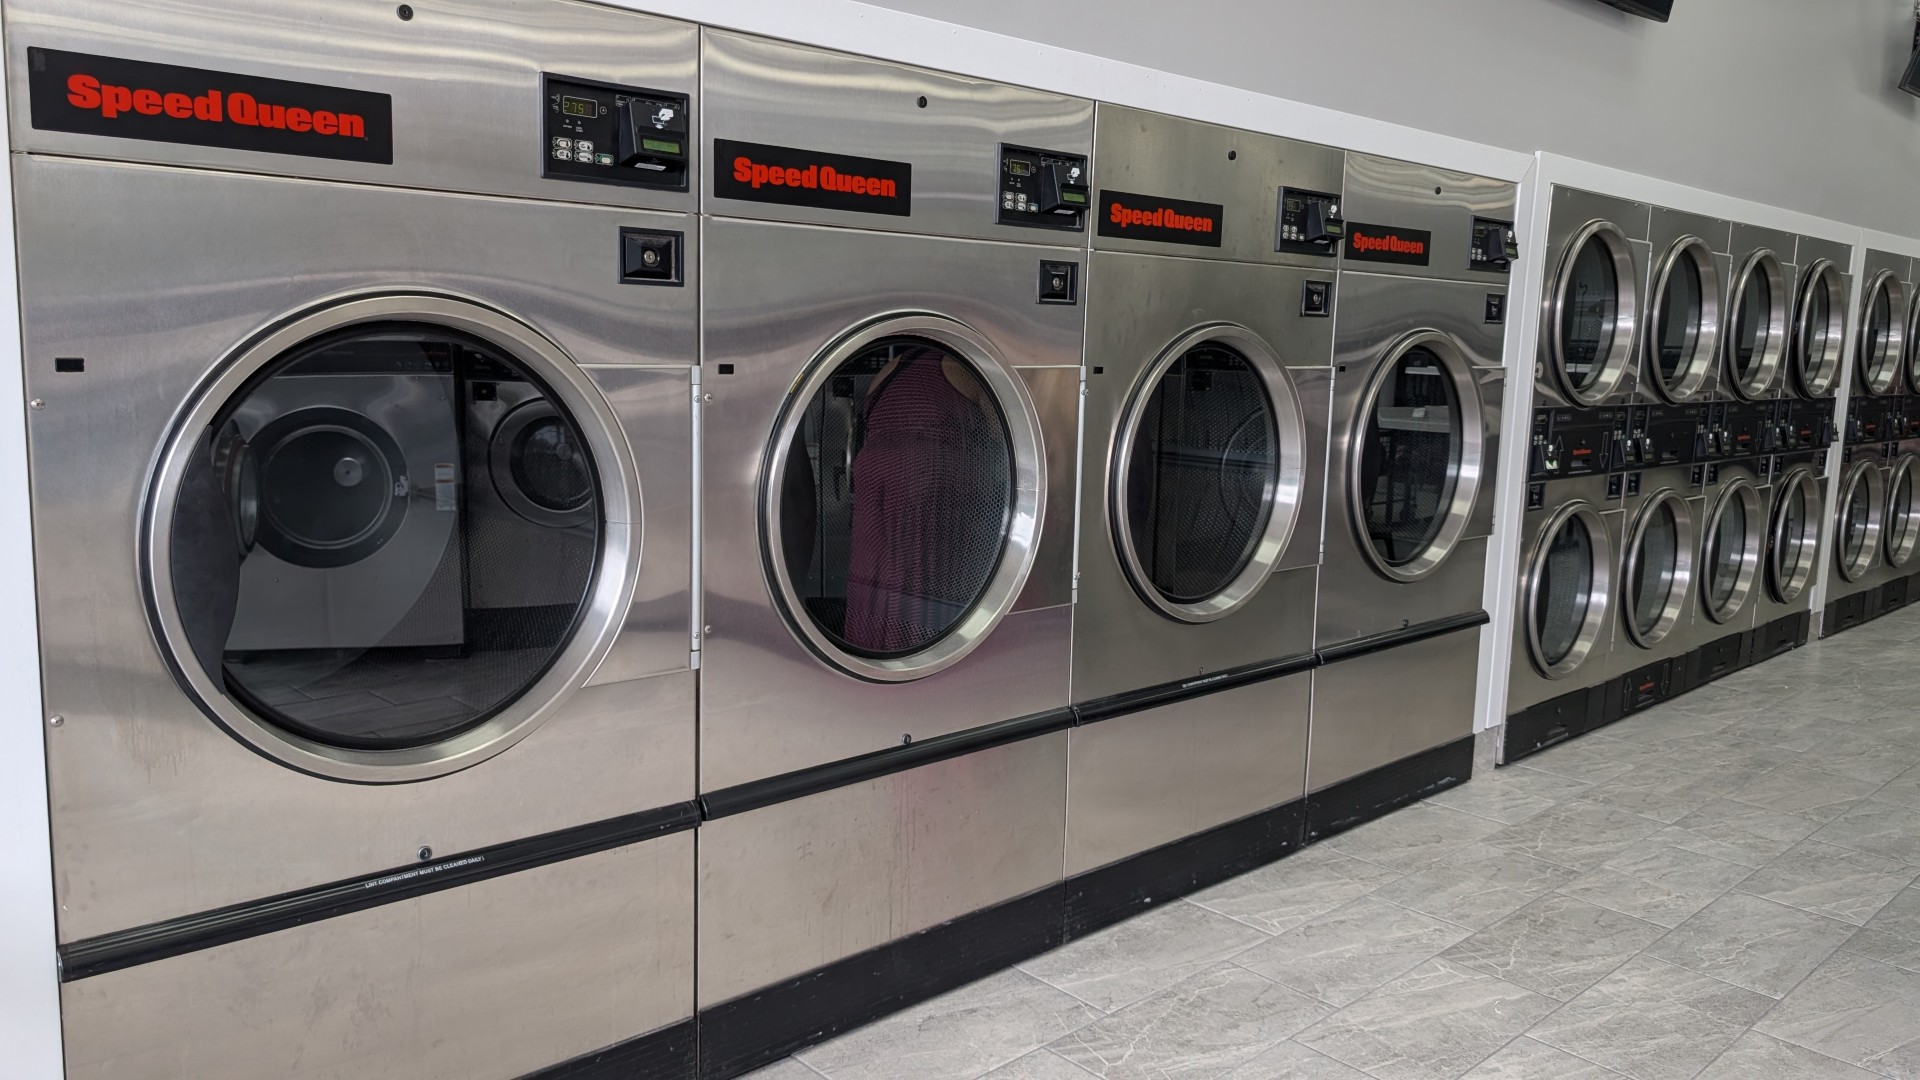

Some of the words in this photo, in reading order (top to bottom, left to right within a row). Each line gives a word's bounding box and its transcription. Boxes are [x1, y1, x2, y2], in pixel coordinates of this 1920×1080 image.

[67, 74, 223, 122] Speed
[227, 92, 365, 138] Queen
[733, 157, 818, 188] Speed
[819, 166, 896, 197] Queen
[1110, 203, 1163, 228] Speed
[1163, 209, 1213, 232] Queen
[1353, 232, 1390, 252] Speed
[1390, 235, 1424, 254] Queen
[378, 871, 419, 885] COMPARTMENT
[443, 859, 468, 870] CLEANED
